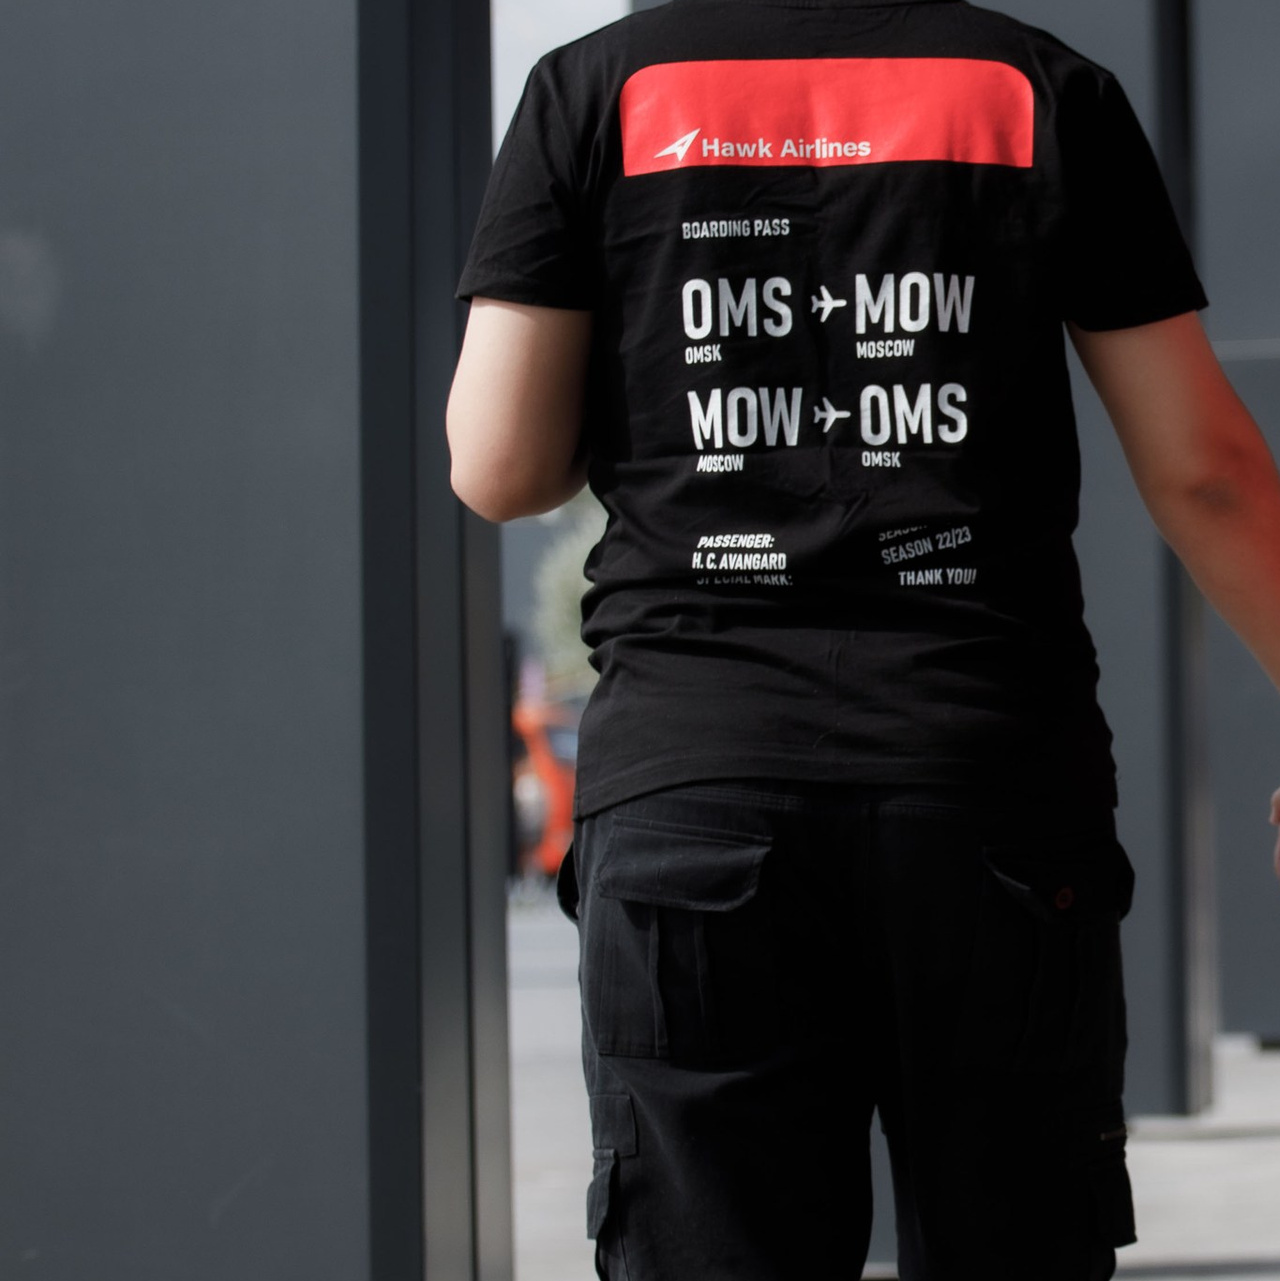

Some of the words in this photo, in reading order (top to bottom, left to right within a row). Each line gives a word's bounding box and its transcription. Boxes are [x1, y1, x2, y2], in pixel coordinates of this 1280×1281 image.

[702, 138, 773, 158] Hawk
[780, 137, 872, 159] Airlines
[682, 220, 751, 240] BOARDING
[754, 218, 790, 236] PASS
[682, 276, 793, 340] OMS
[855, 271, 975, 335] MOW
[685, 344, 722, 365] OMSK
[856, 339, 915, 359] MOSCOW
[687, 386, 803, 450] MOW
[859, 382, 968, 446] OMS
[697, 454, 745, 473] MOSCOW
[861, 451, 901, 468] OMSK
[697, 533, 775, 549] PASSENGER:
[881, 536, 934, 565] SEASON
[935, 525, 972, 550] 22/23
[691, 551, 704, 570] H.
[718, 552, 787, 570] AVANGARD
[898, 569, 943, 586] THANK
[946, 567, 977, 585] YOU!
